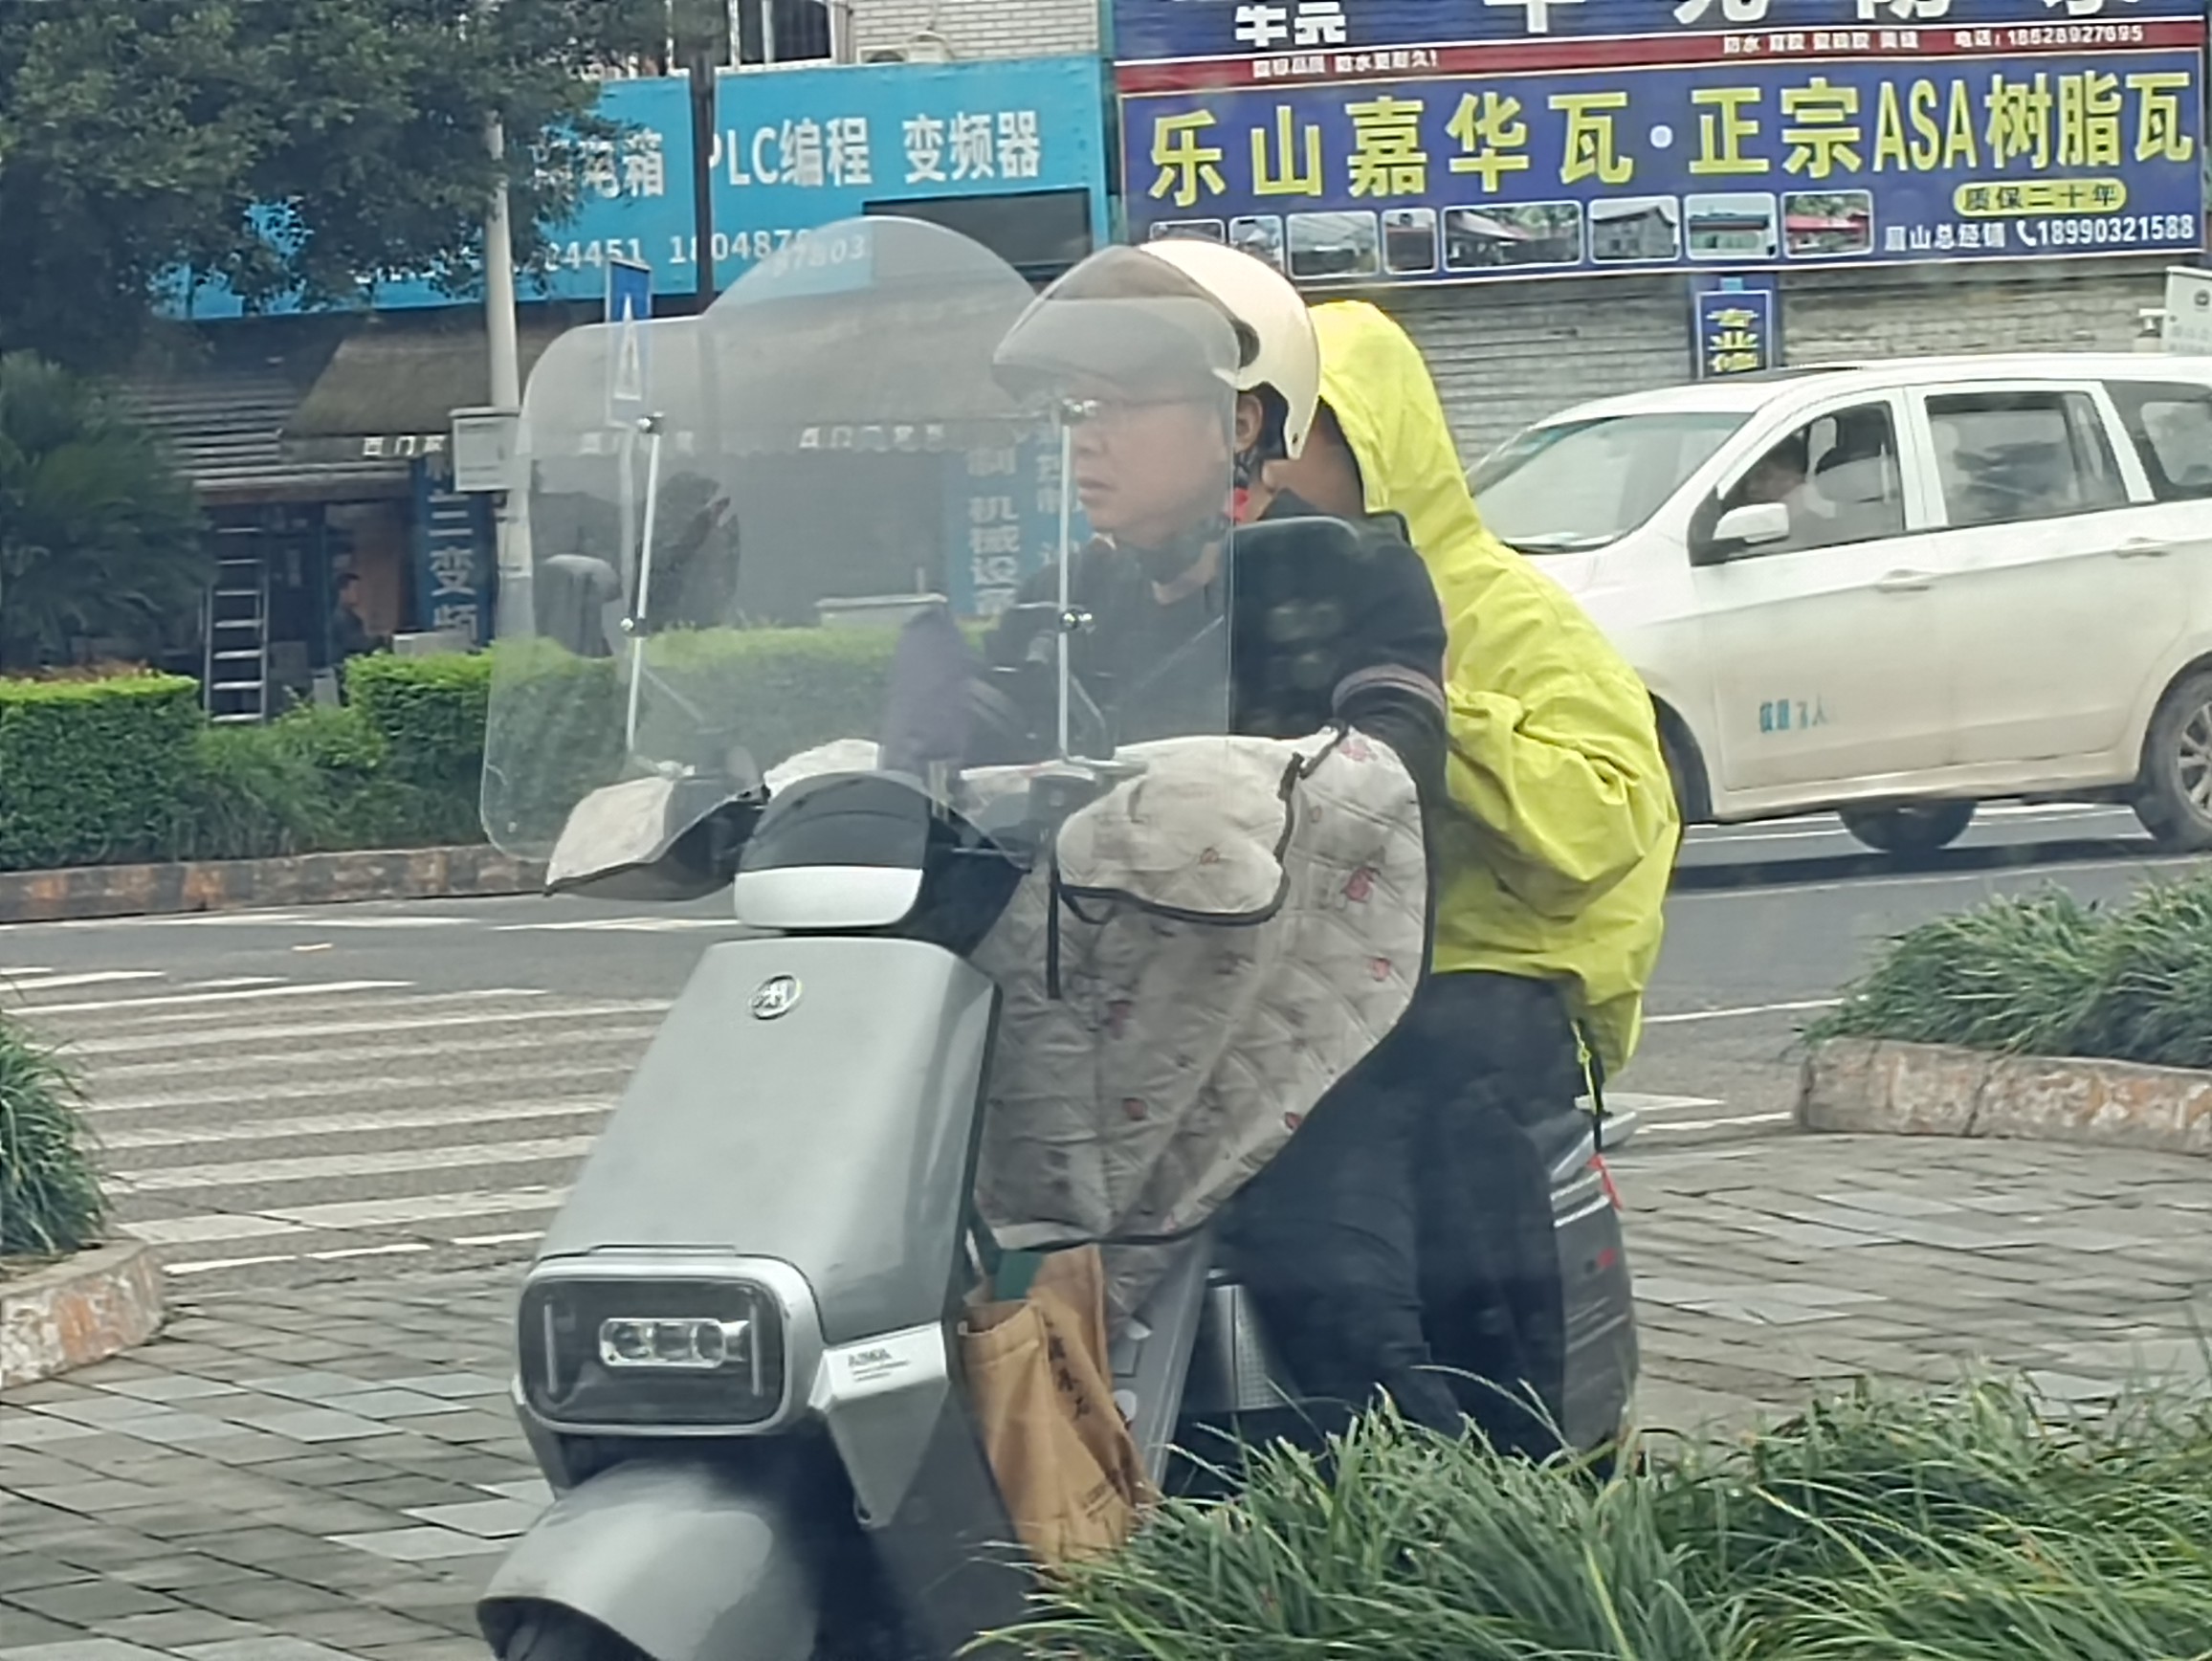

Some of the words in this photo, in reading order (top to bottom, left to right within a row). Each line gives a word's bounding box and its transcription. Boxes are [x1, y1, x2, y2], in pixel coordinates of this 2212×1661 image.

[903, 111, 1041, 185] 变频器
[1965, 184, 2117, 211] 质保二十年
[2037, 214, 2195, 246] 18990321588
